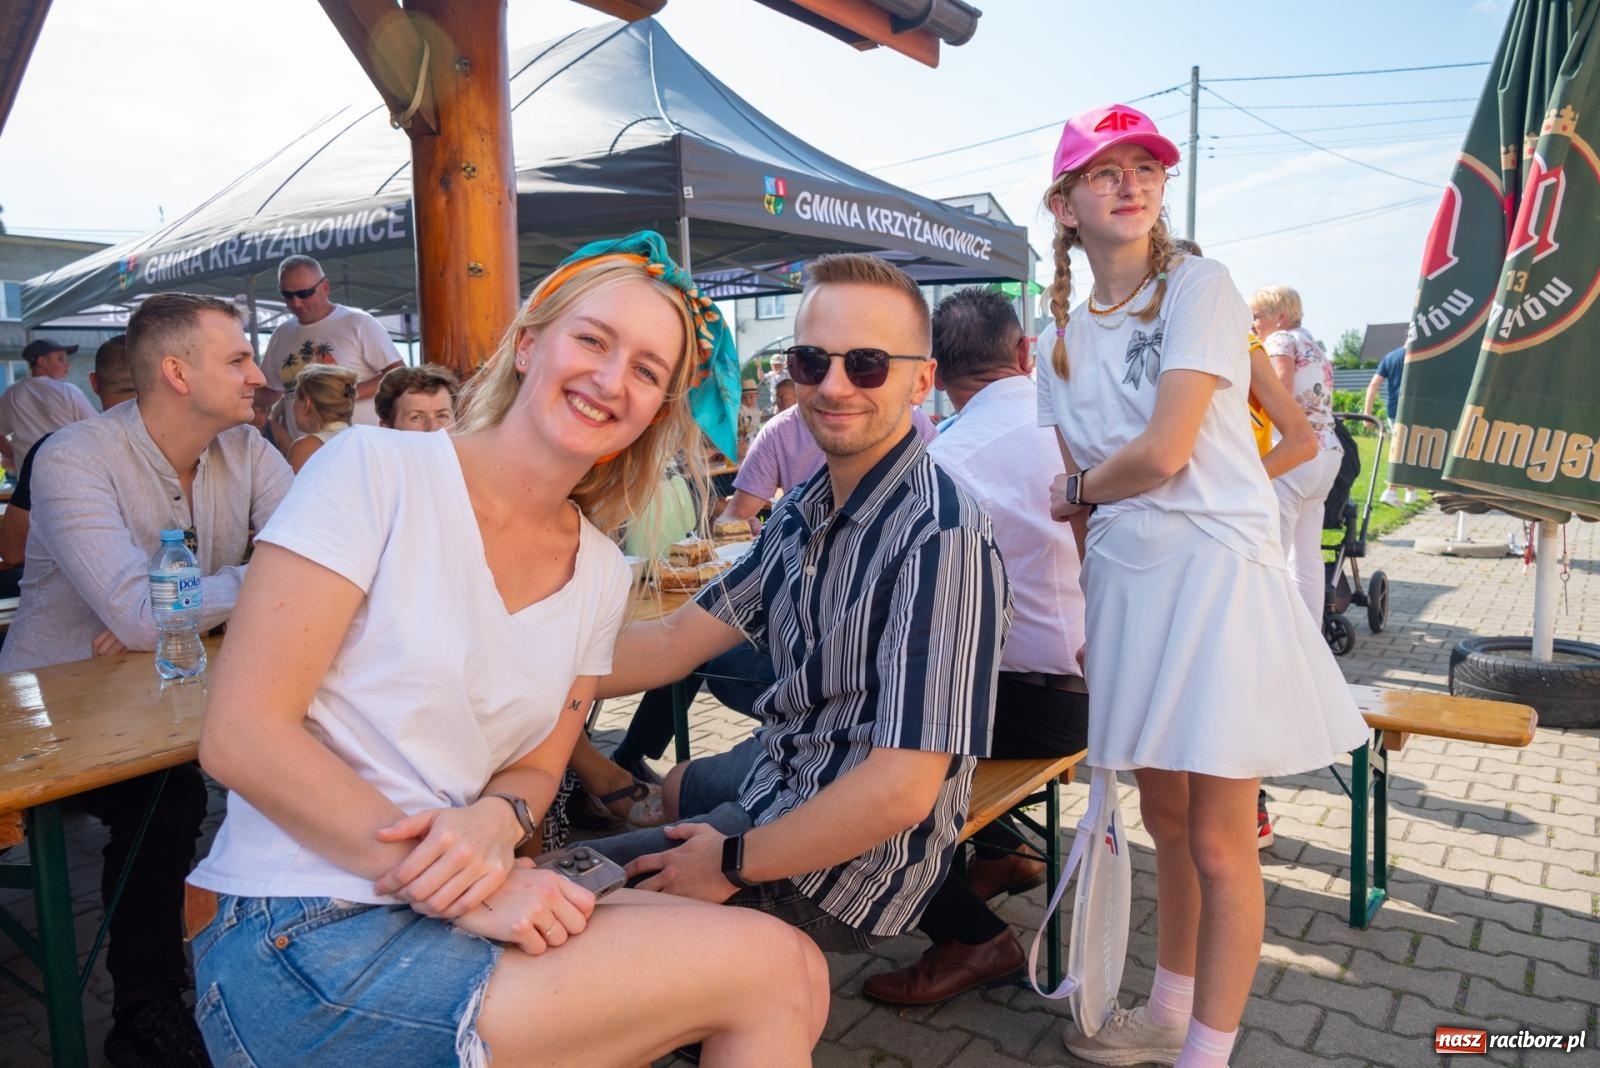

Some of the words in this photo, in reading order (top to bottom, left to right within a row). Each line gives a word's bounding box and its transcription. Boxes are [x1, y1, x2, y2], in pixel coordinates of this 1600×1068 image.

[144, 249, 204, 284] GMINA
[209, 202, 406, 271] KRZYŻANOWICE
[795, 191, 865, 229] GMINA
[867, 206, 992, 260] KRZYŻANOWICE
